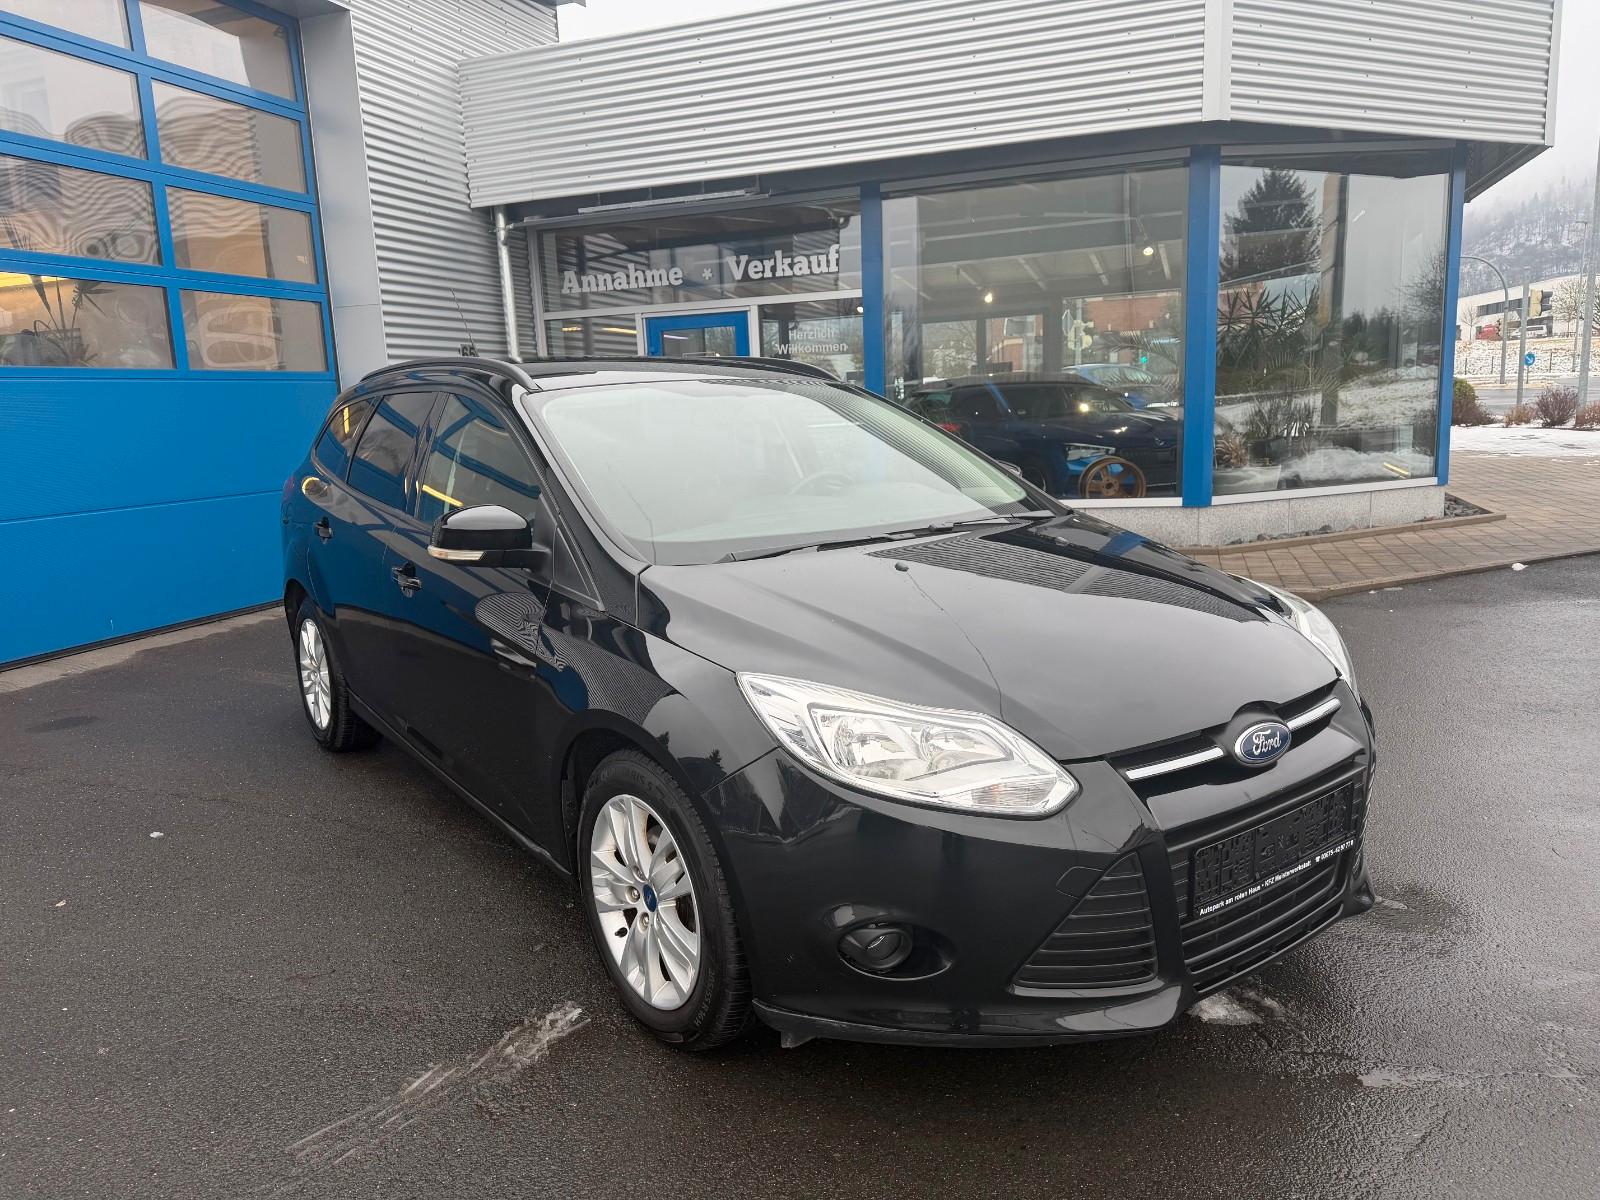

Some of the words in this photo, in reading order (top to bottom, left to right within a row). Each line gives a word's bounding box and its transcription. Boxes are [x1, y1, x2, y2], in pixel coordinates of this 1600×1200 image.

[561, 264, 684, 294] Annahme
[727, 244, 840, 282] Verkauf
[777, 342, 848, 355] Willkommen
[1252, 729, 1282, 756] Ford
[1199, 900, 1225, 916] Autopark
[1225, 897, 1234, 905] am
[1248, 885, 1261, 895] Haus
[1264, 876, 1275, 888] KFZ
